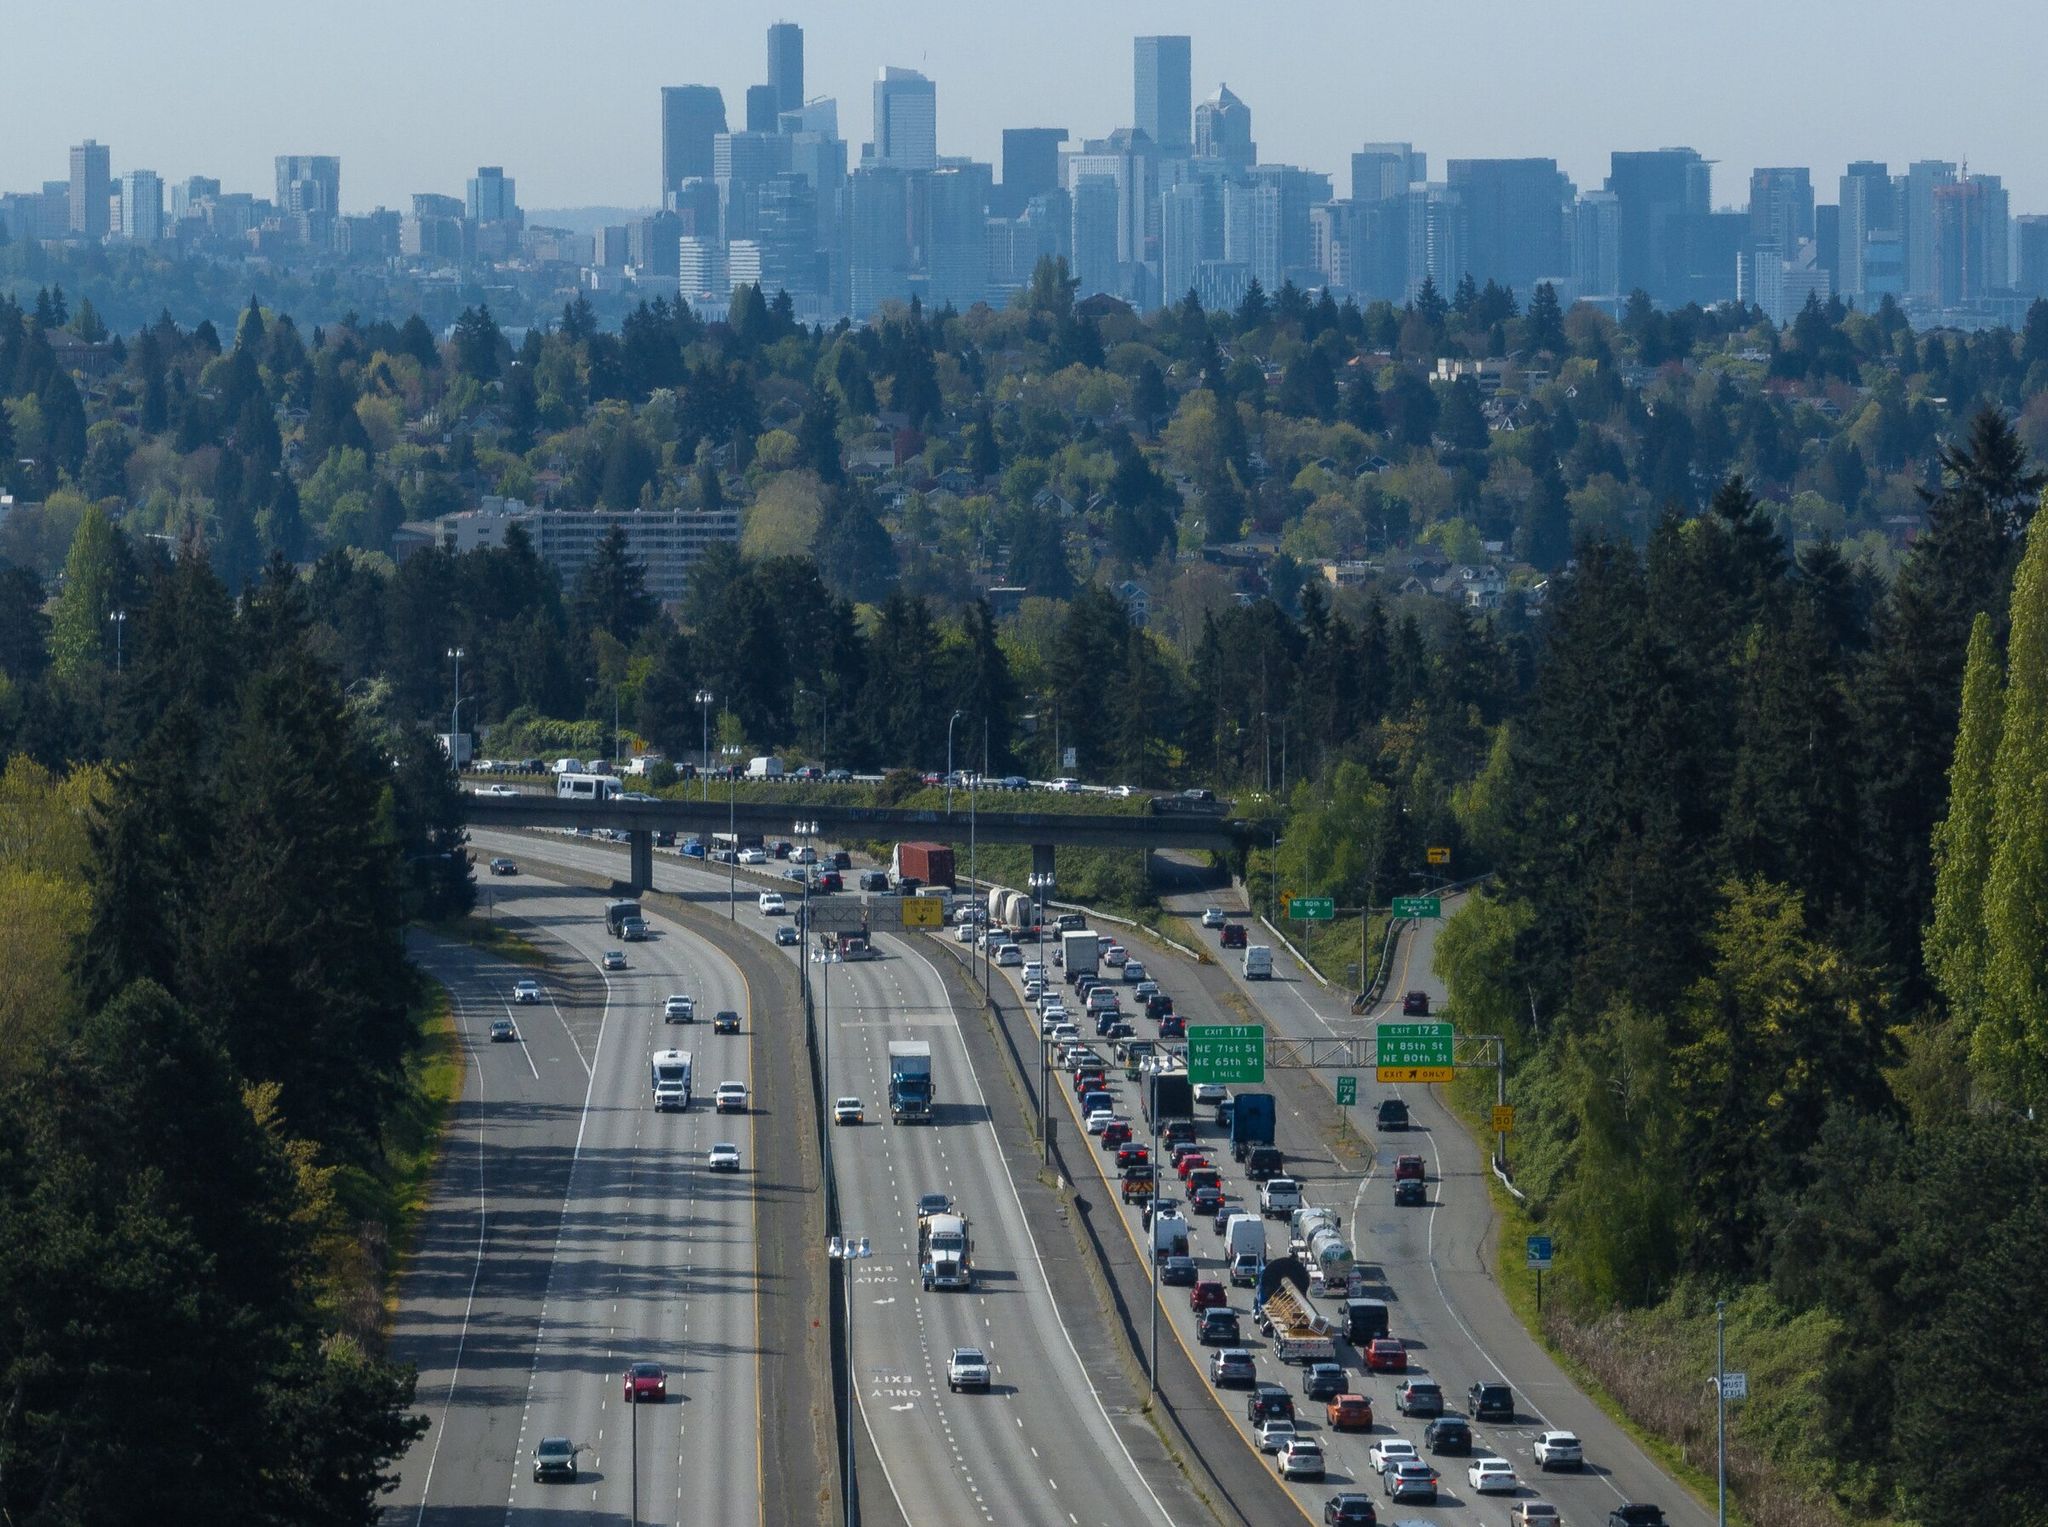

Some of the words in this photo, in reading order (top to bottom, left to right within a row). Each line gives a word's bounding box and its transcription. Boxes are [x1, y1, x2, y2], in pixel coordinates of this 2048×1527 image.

[1204, 1028, 1223, 1036] EXIT
[1230, 1027, 1247, 1036] 171
[1417, 1025, 1439, 1035] 172
[1195, 1044, 1211, 1053] NE
[1217, 1044, 1240, 1053] 71st
[1245, 1044, 1256, 1053] St
[1387, 1042, 1394, 1050] N
[1400, 1042, 1426, 1050] 85th
[1431, 1042, 1443, 1050] St
[1194, 1057, 1209, 1066] NE
[1215, 1057, 1241, 1066] 65th
[1247, 1057, 1258, 1066] St
[1383, 1054, 1397, 1063] NE
[1403, 1054, 1430, 1062] 80th
[1436, 1054, 1447, 1062] St
[1339, 1085, 1355, 1093] 172
[1495, 1117, 1510, 1125] 50
[872, 1375, 912, 1383] EXIT
[872, 1389, 921, 1397] ONLY
